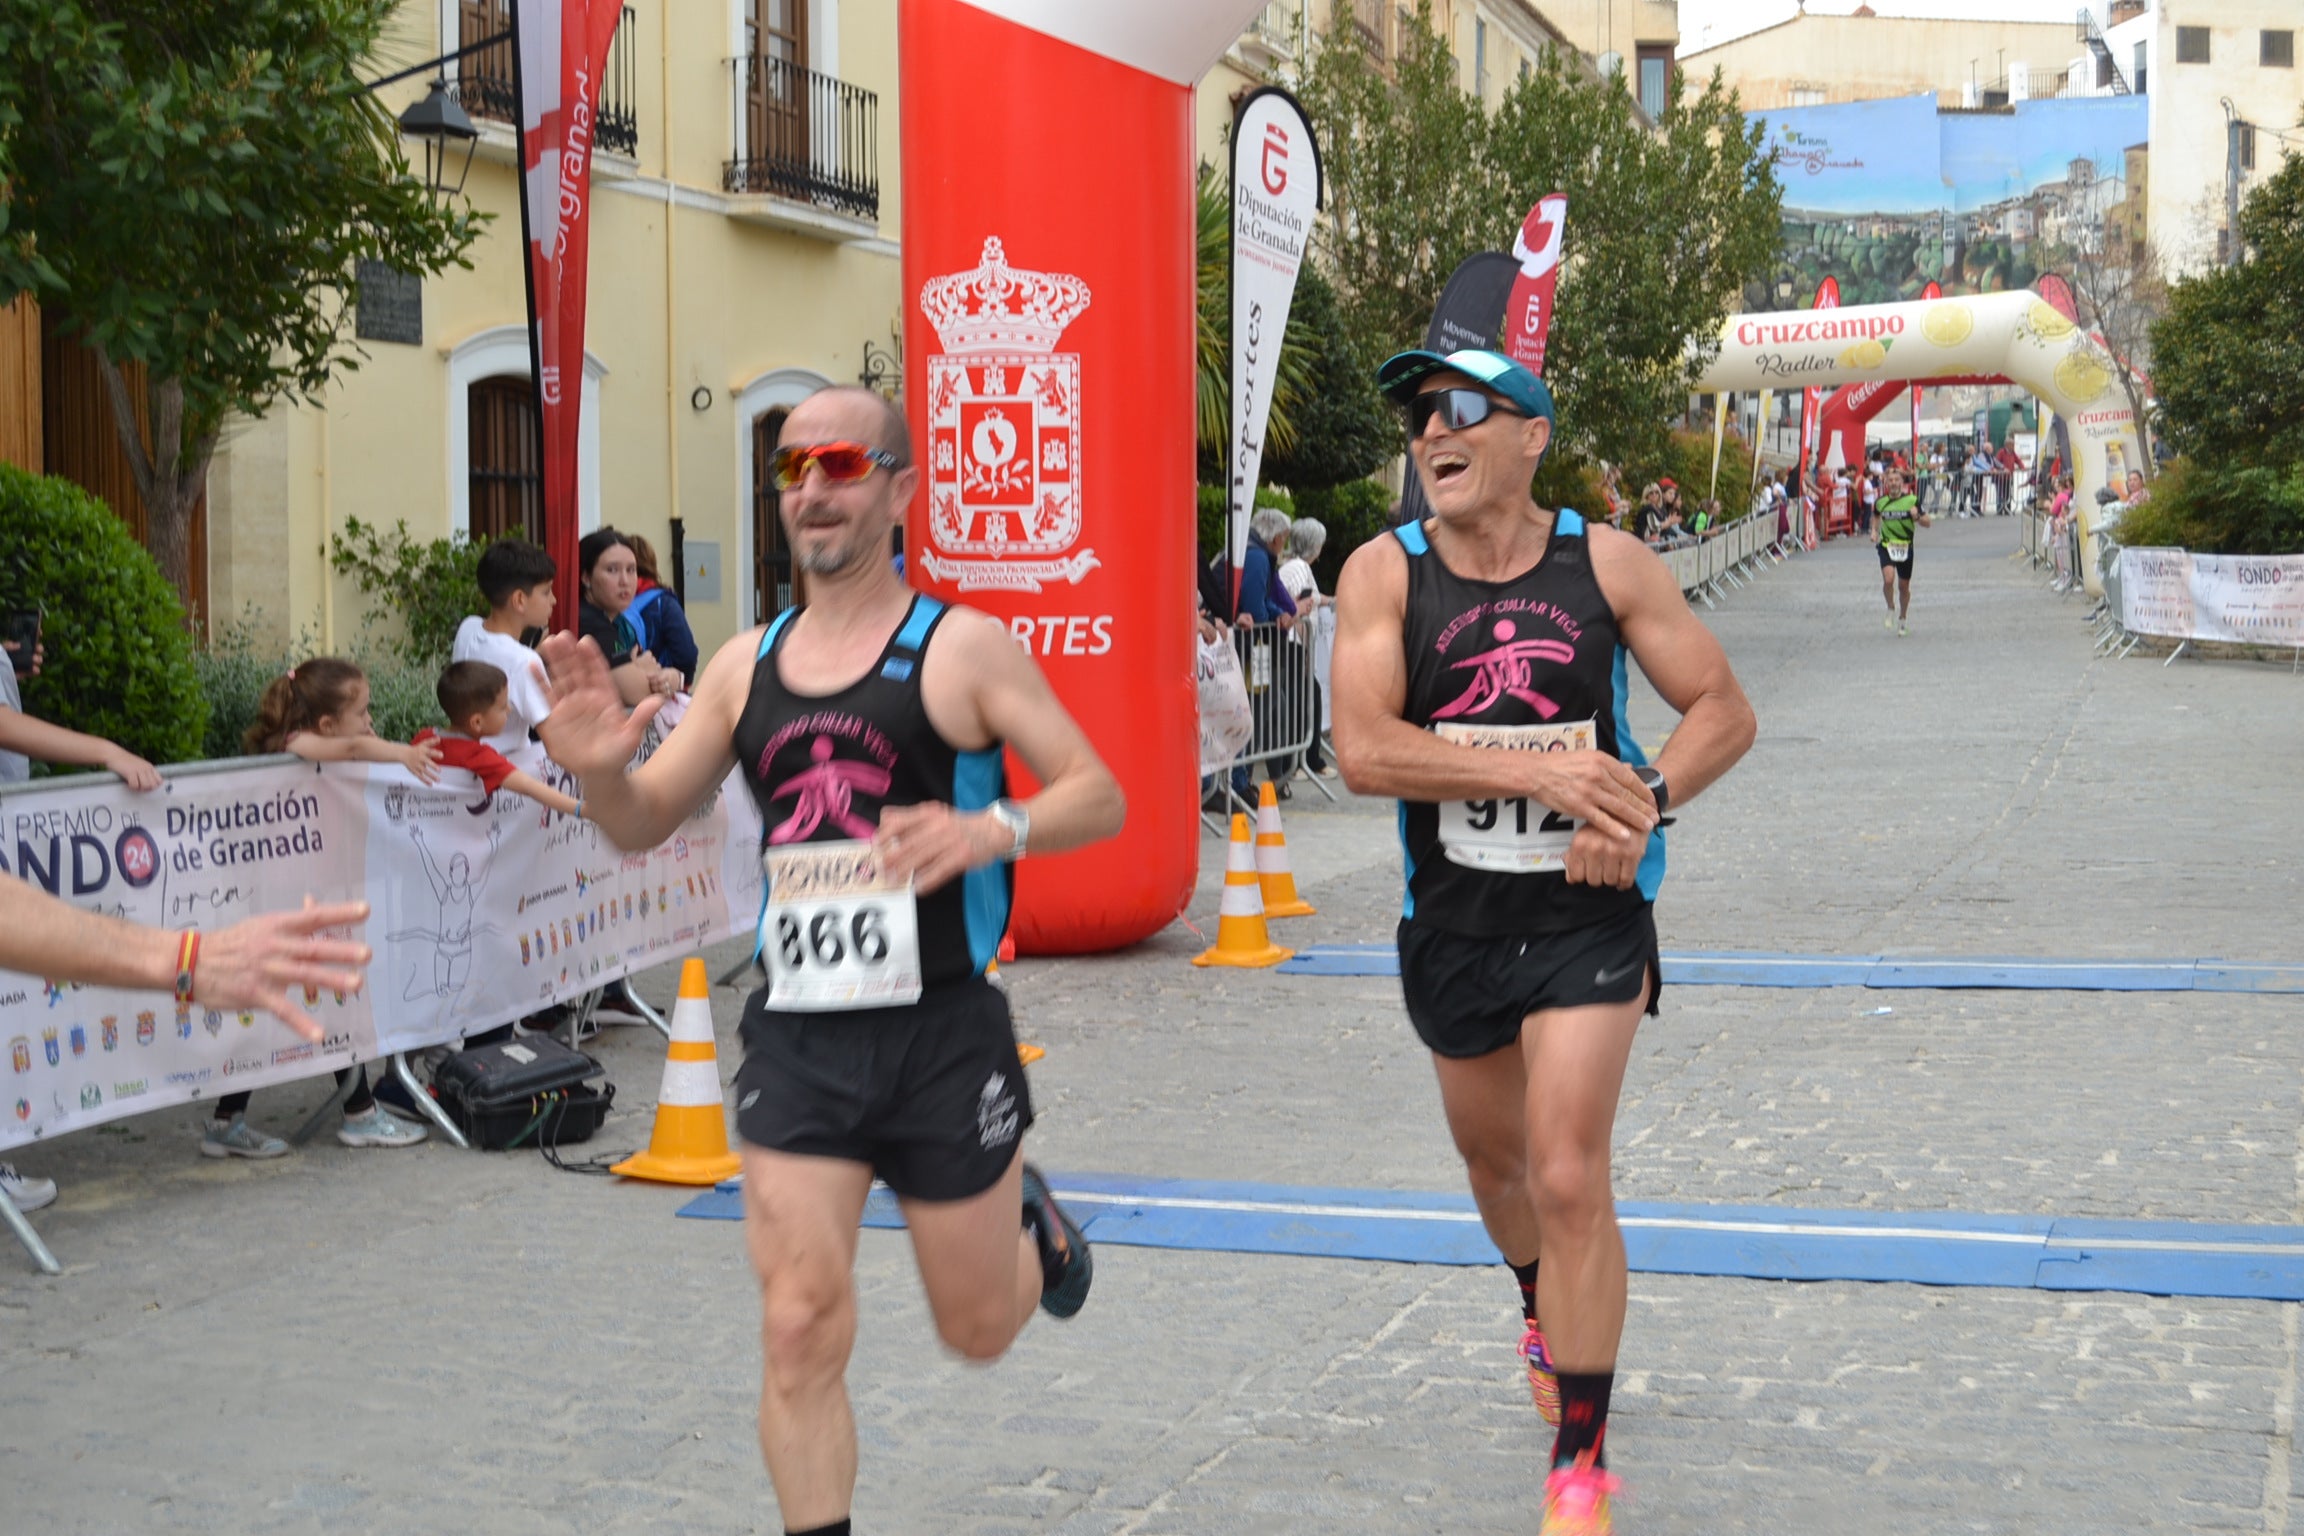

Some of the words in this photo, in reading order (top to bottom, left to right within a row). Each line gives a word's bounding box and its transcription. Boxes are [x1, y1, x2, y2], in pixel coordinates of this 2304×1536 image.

[1238, 184, 1302, 233] Diputación
[1251, 219, 1300, 258] Granada
[1440, 335, 1457, 351] that
[1443, 318, 1486, 347] Movement
[1737, 313, 1904, 347] Cruzcampo
[1755, 354, 1837, 377] Radler
[2078, 408, 2134, 425] Cruzcam
[966, 574, 1028, 584] GRANADA
[1550, 604, 1583, 641] VEGA
[16, 804, 113, 842] PREMIO
[121, 811, 141, 829] DE
[166, 790, 319, 841] Diputación
[1465, 797, 1575, 836] 912
[0, 826, 161, 898] NDO
[126, 845, 150, 870] 24
[172, 843, 204, 873] de
[210, 825, 324, 868] Granada
[775, 903, 889, 972] 866
